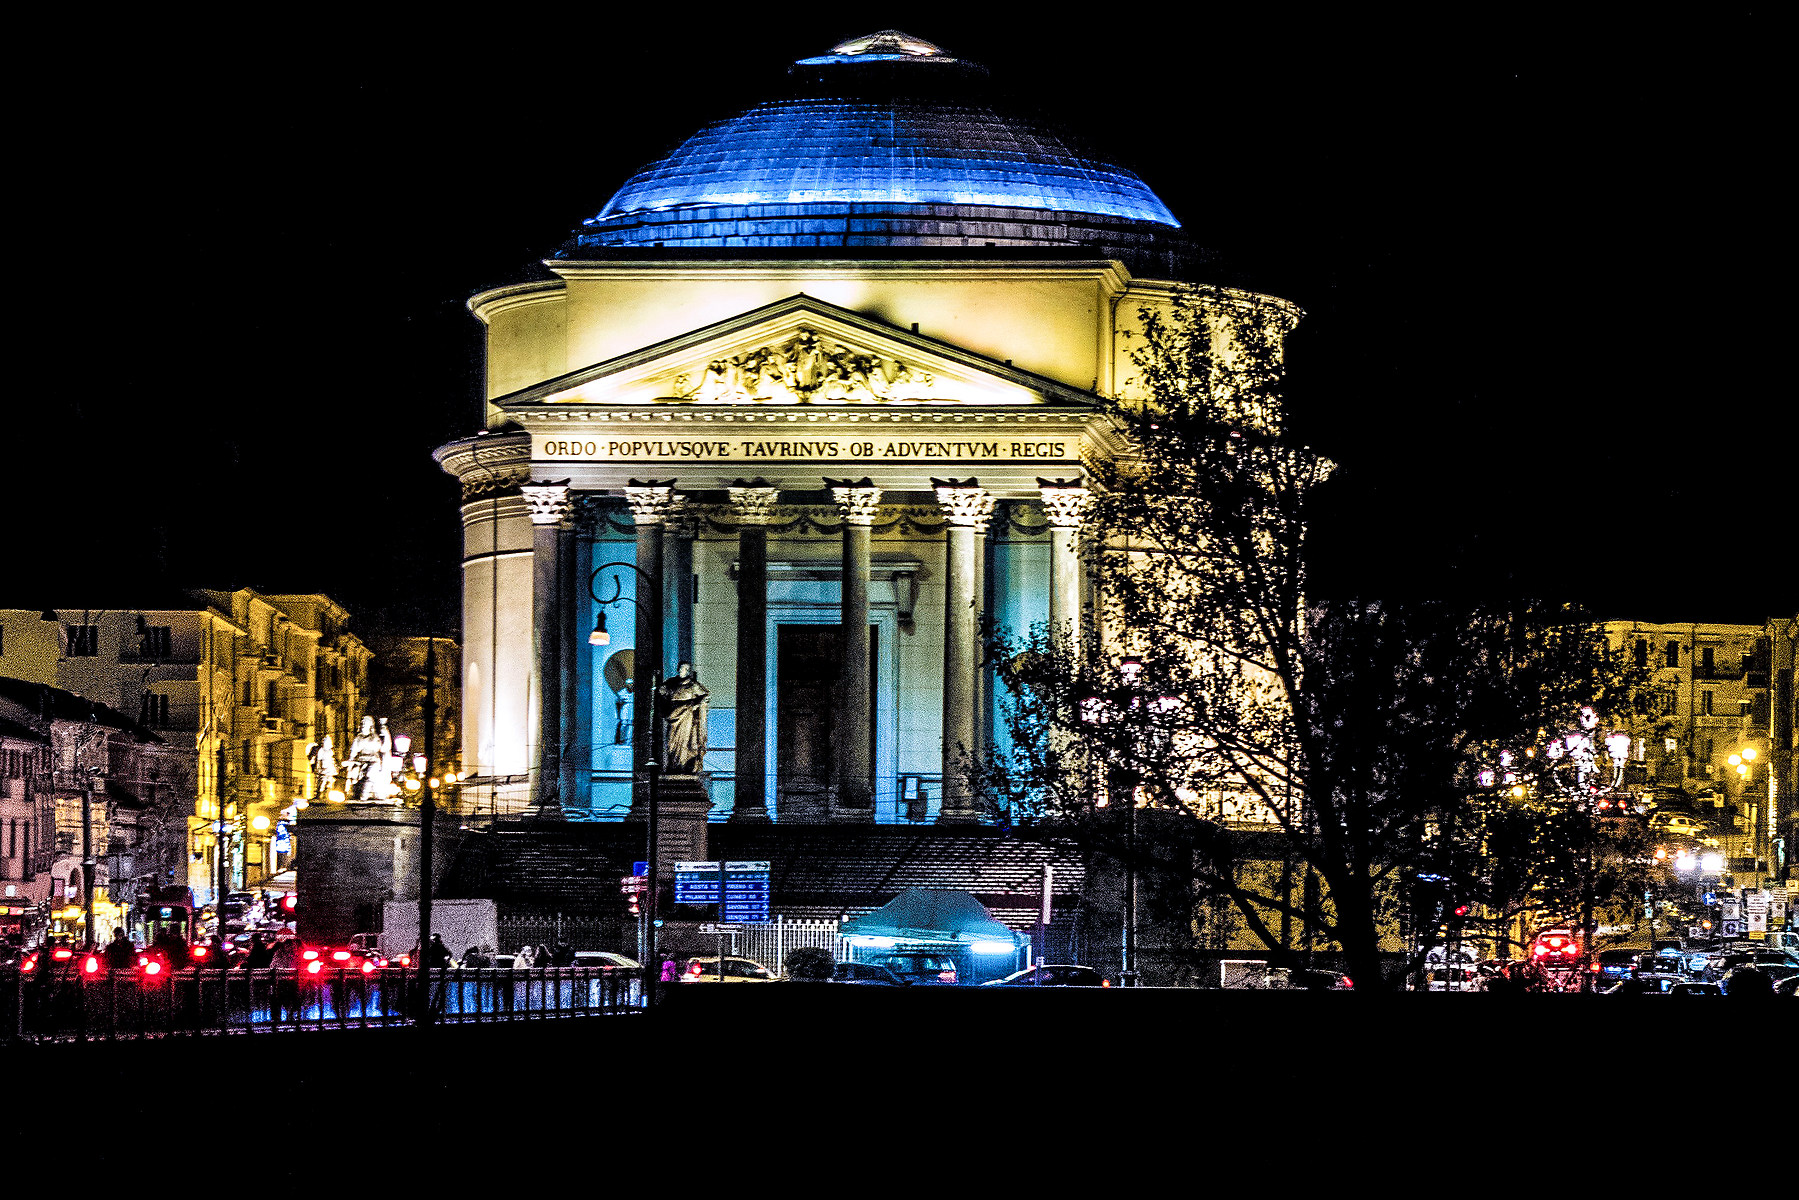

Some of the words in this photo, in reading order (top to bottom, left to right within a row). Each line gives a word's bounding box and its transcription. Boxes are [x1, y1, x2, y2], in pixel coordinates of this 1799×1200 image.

[544, 441, 597, 457] ORDO
[608, 441, 730, 459] POPVLVSQVE
[741, 441, 839, 457] TAVRINVS
[850, 442, 874, 457] OB
[883, 442, 999, 457] ADVENTVM
[1010, 442, 1065, 458] REGIS
